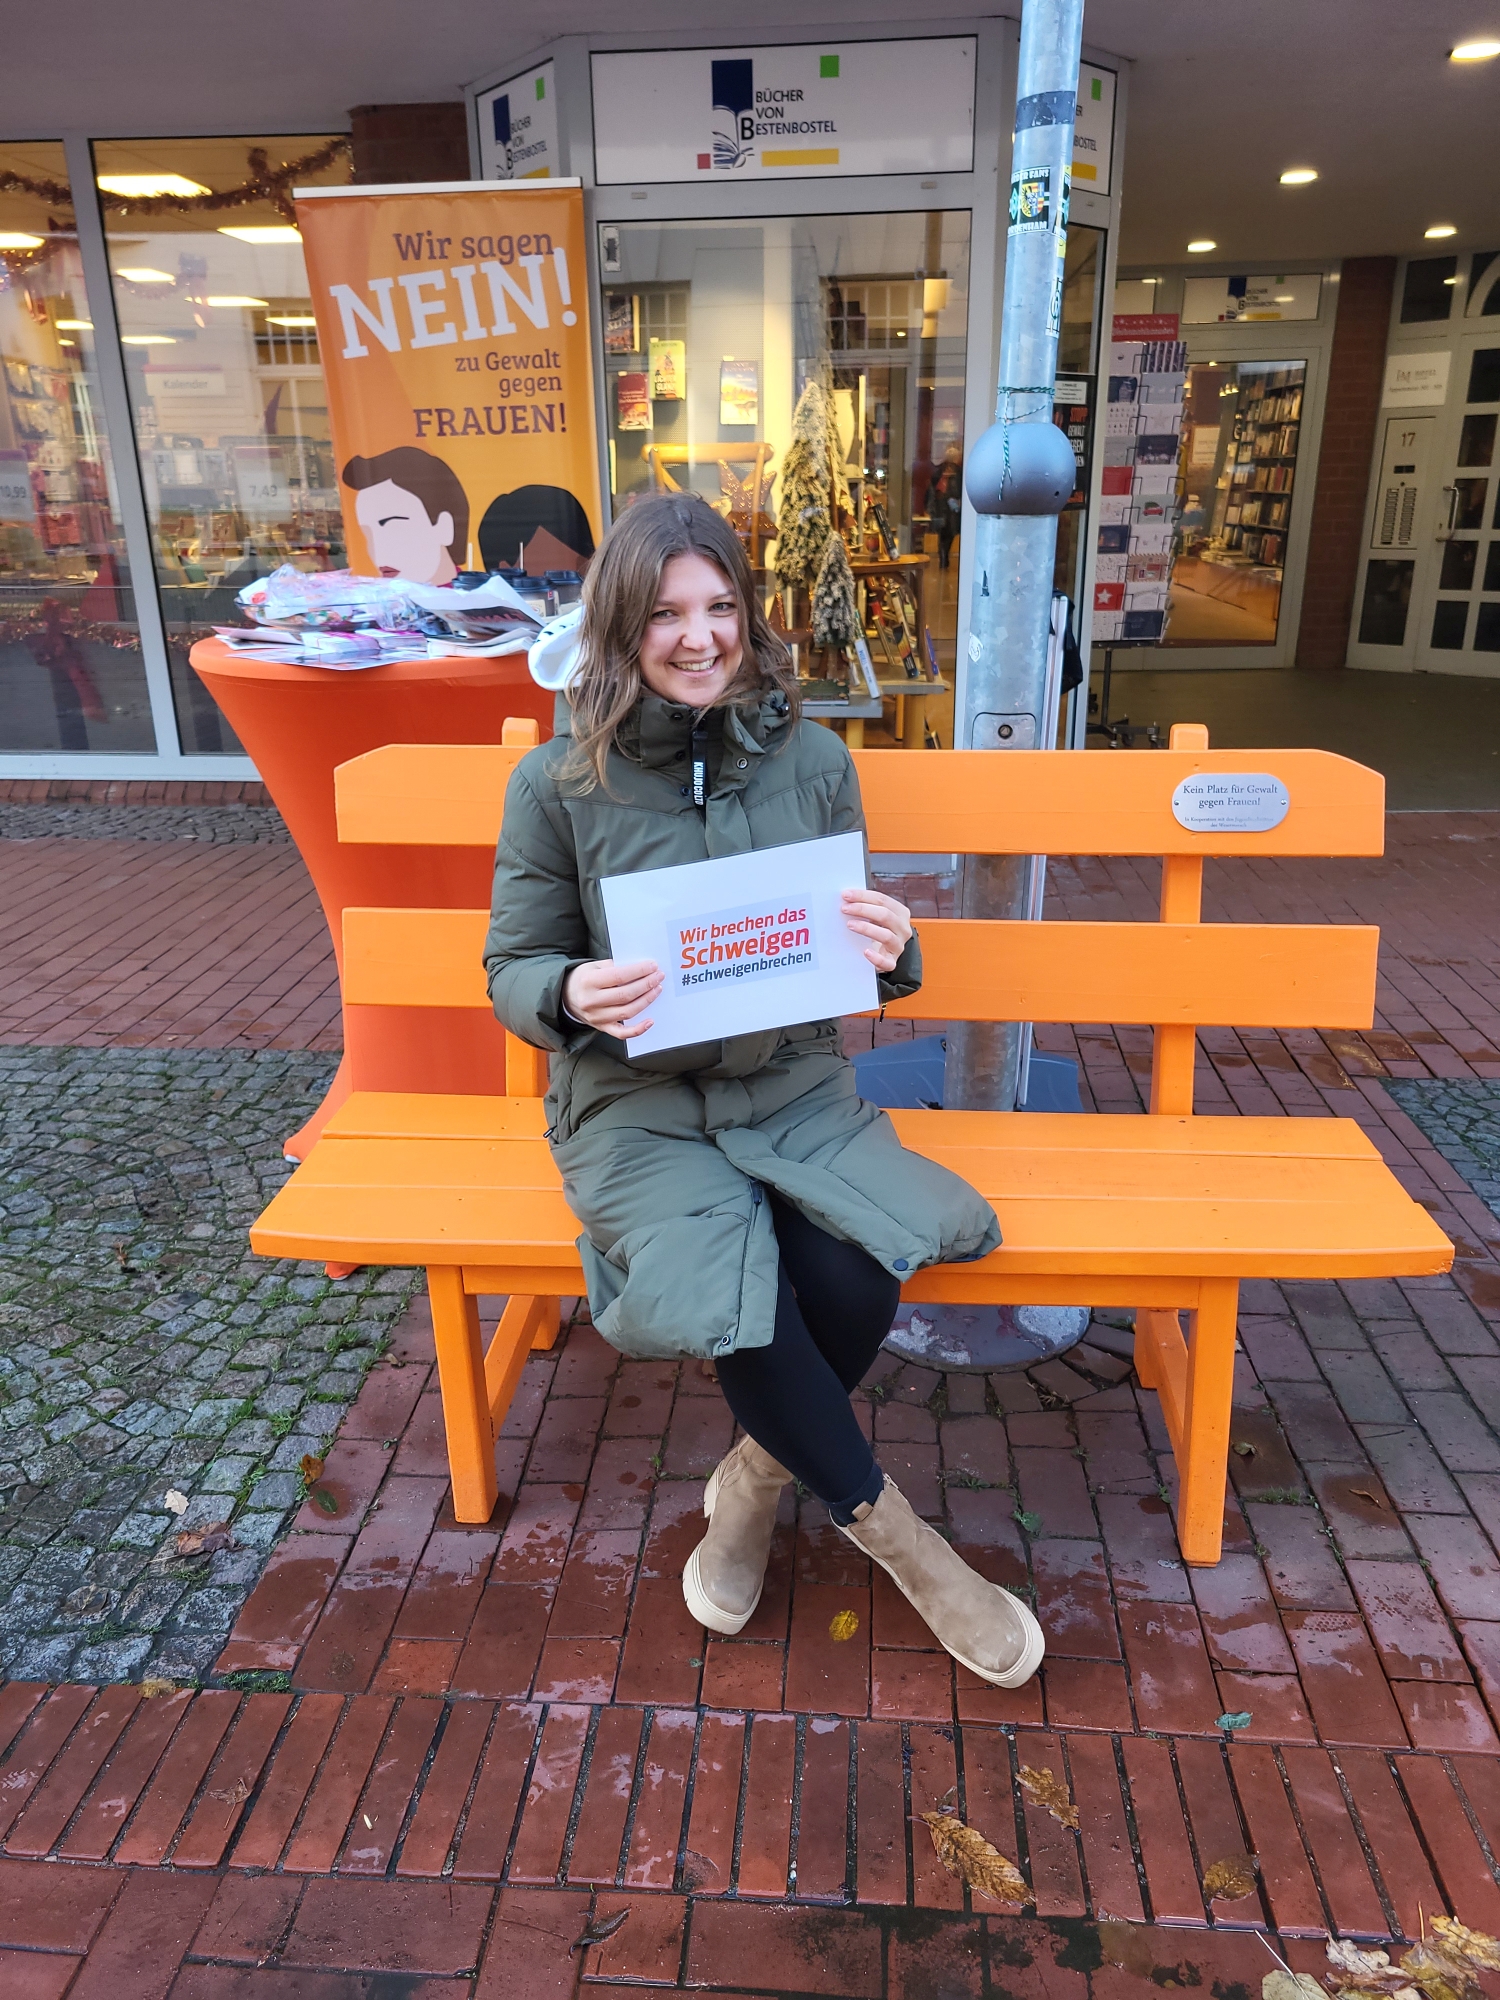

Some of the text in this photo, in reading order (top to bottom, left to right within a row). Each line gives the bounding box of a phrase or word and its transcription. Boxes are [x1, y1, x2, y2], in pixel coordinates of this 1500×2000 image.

[755, 88, 804, 103] BÜCHER
[755, 107, 784, 119] VON
[741, 117, 837, 141] BESTENBOSTEL
[392, 230, 555, 266] Wir sagen
[328, 247, 578, 360] NEIN!
[455, 349, 561, 372] zu Gewalt
[499, 375, 563, 399] gegen
[413, 402, 568, 438] FRAUEN!
[1402, 432, 1416, 447] 17
[693, 761, 704, 785] KHUJO
[1183, 784, 1278, 794] Kein Platz für Gewalt
[1198, 797, 1260, 809] gegen Frauen!
[680, 908, 807, 945] Wir brechen das
[680, 927, 810, 970] Schweigen
[681, 952, 812, 986] #schweigenbrechen
